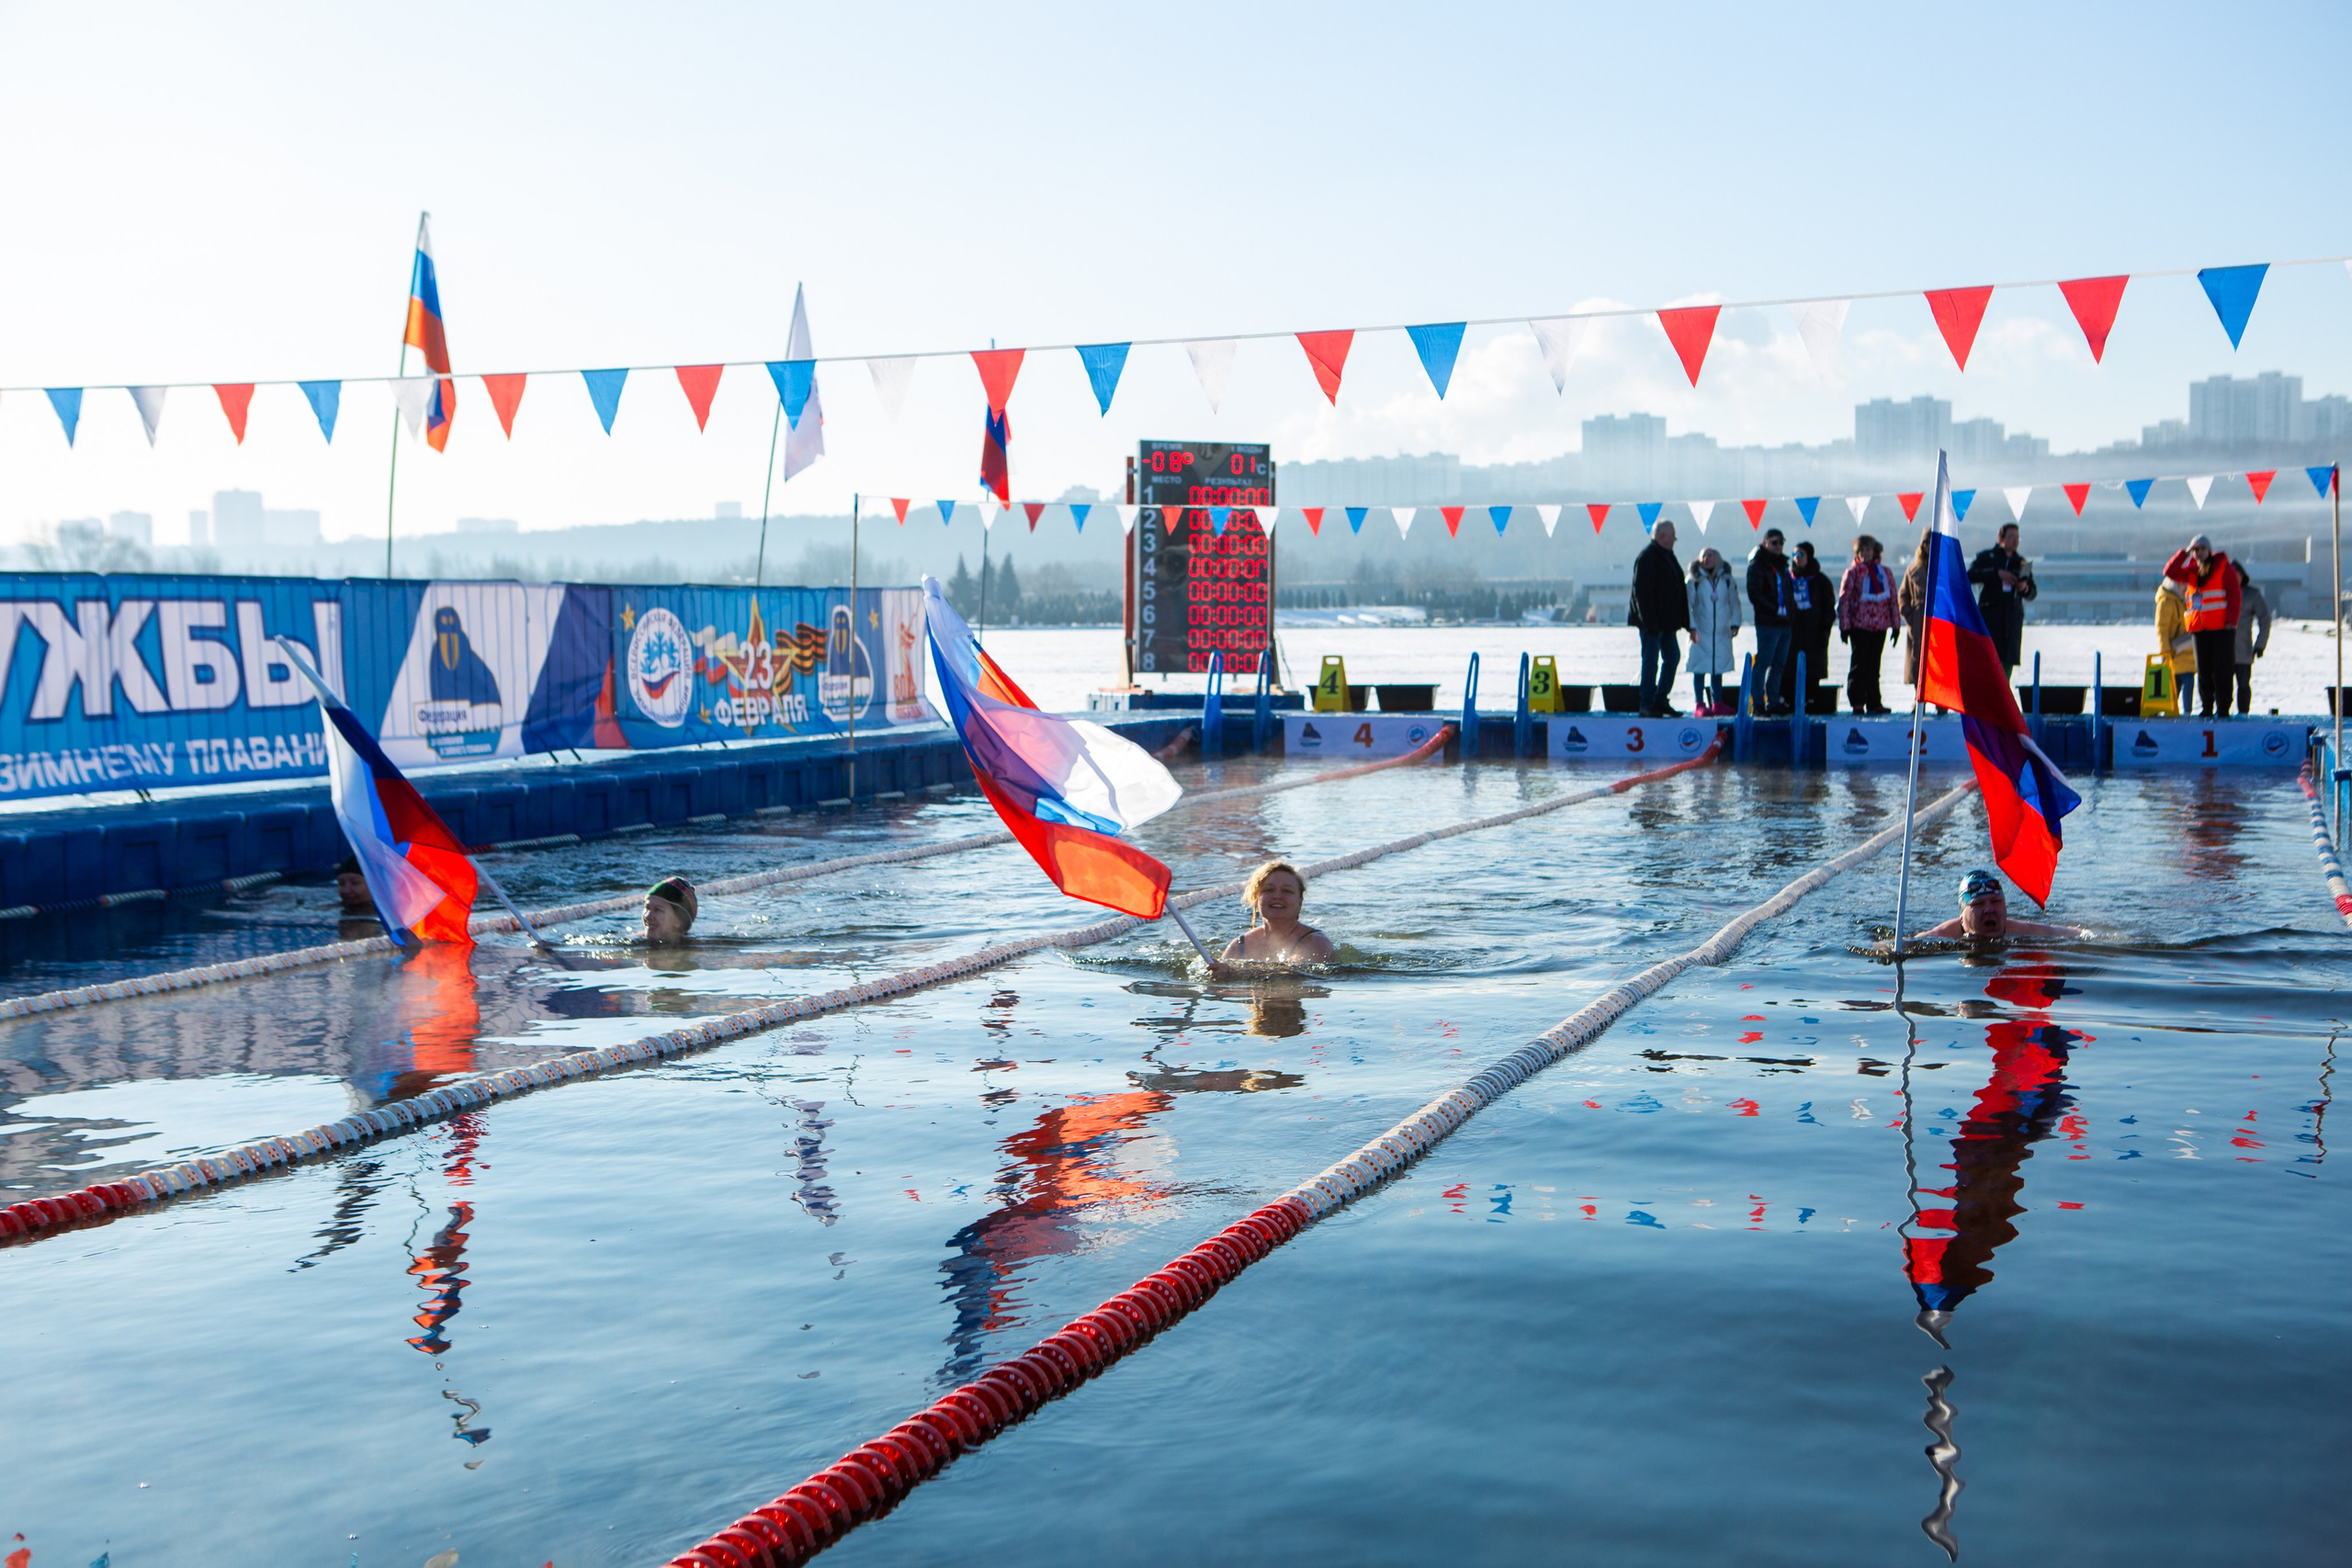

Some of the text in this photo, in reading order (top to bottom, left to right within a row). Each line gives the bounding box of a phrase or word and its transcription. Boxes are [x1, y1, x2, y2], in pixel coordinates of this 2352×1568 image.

[1150, 475, 1182, 485] МЕСТО
[1143, 485, 1269, 507] 1 00:00:00
[1143, 509, 1157, 530] 2
[1143, 533, 1268, 556] 3 00:00:00
[1142, 557, 1157, 577] 4
[1142, 581, 1268, 603] 5 00:00:00
[1142, 604, 1267, 626] 6 00:00:00
[1142, 628, 1267, 650] 7 00:00:00
[740, 640, 775, 691] 23
[1142, 652, 1156, 671] 8
[1321, 670, 1340, 695] 4
[1532, 670, 1551, 695] 3
[2148, 669, 2167, 700] 1
[417, 709, 468, 725] Федерация
[714, 694, 809, 728] ФЕВРАЛЯ
[1353, 722, 1374, 749] 4
[1625, 726, 1645, 753] 3
[2201, 729, 2220, 759] 1
[0, 741, 175, 793] ЗИМНЕМУ
